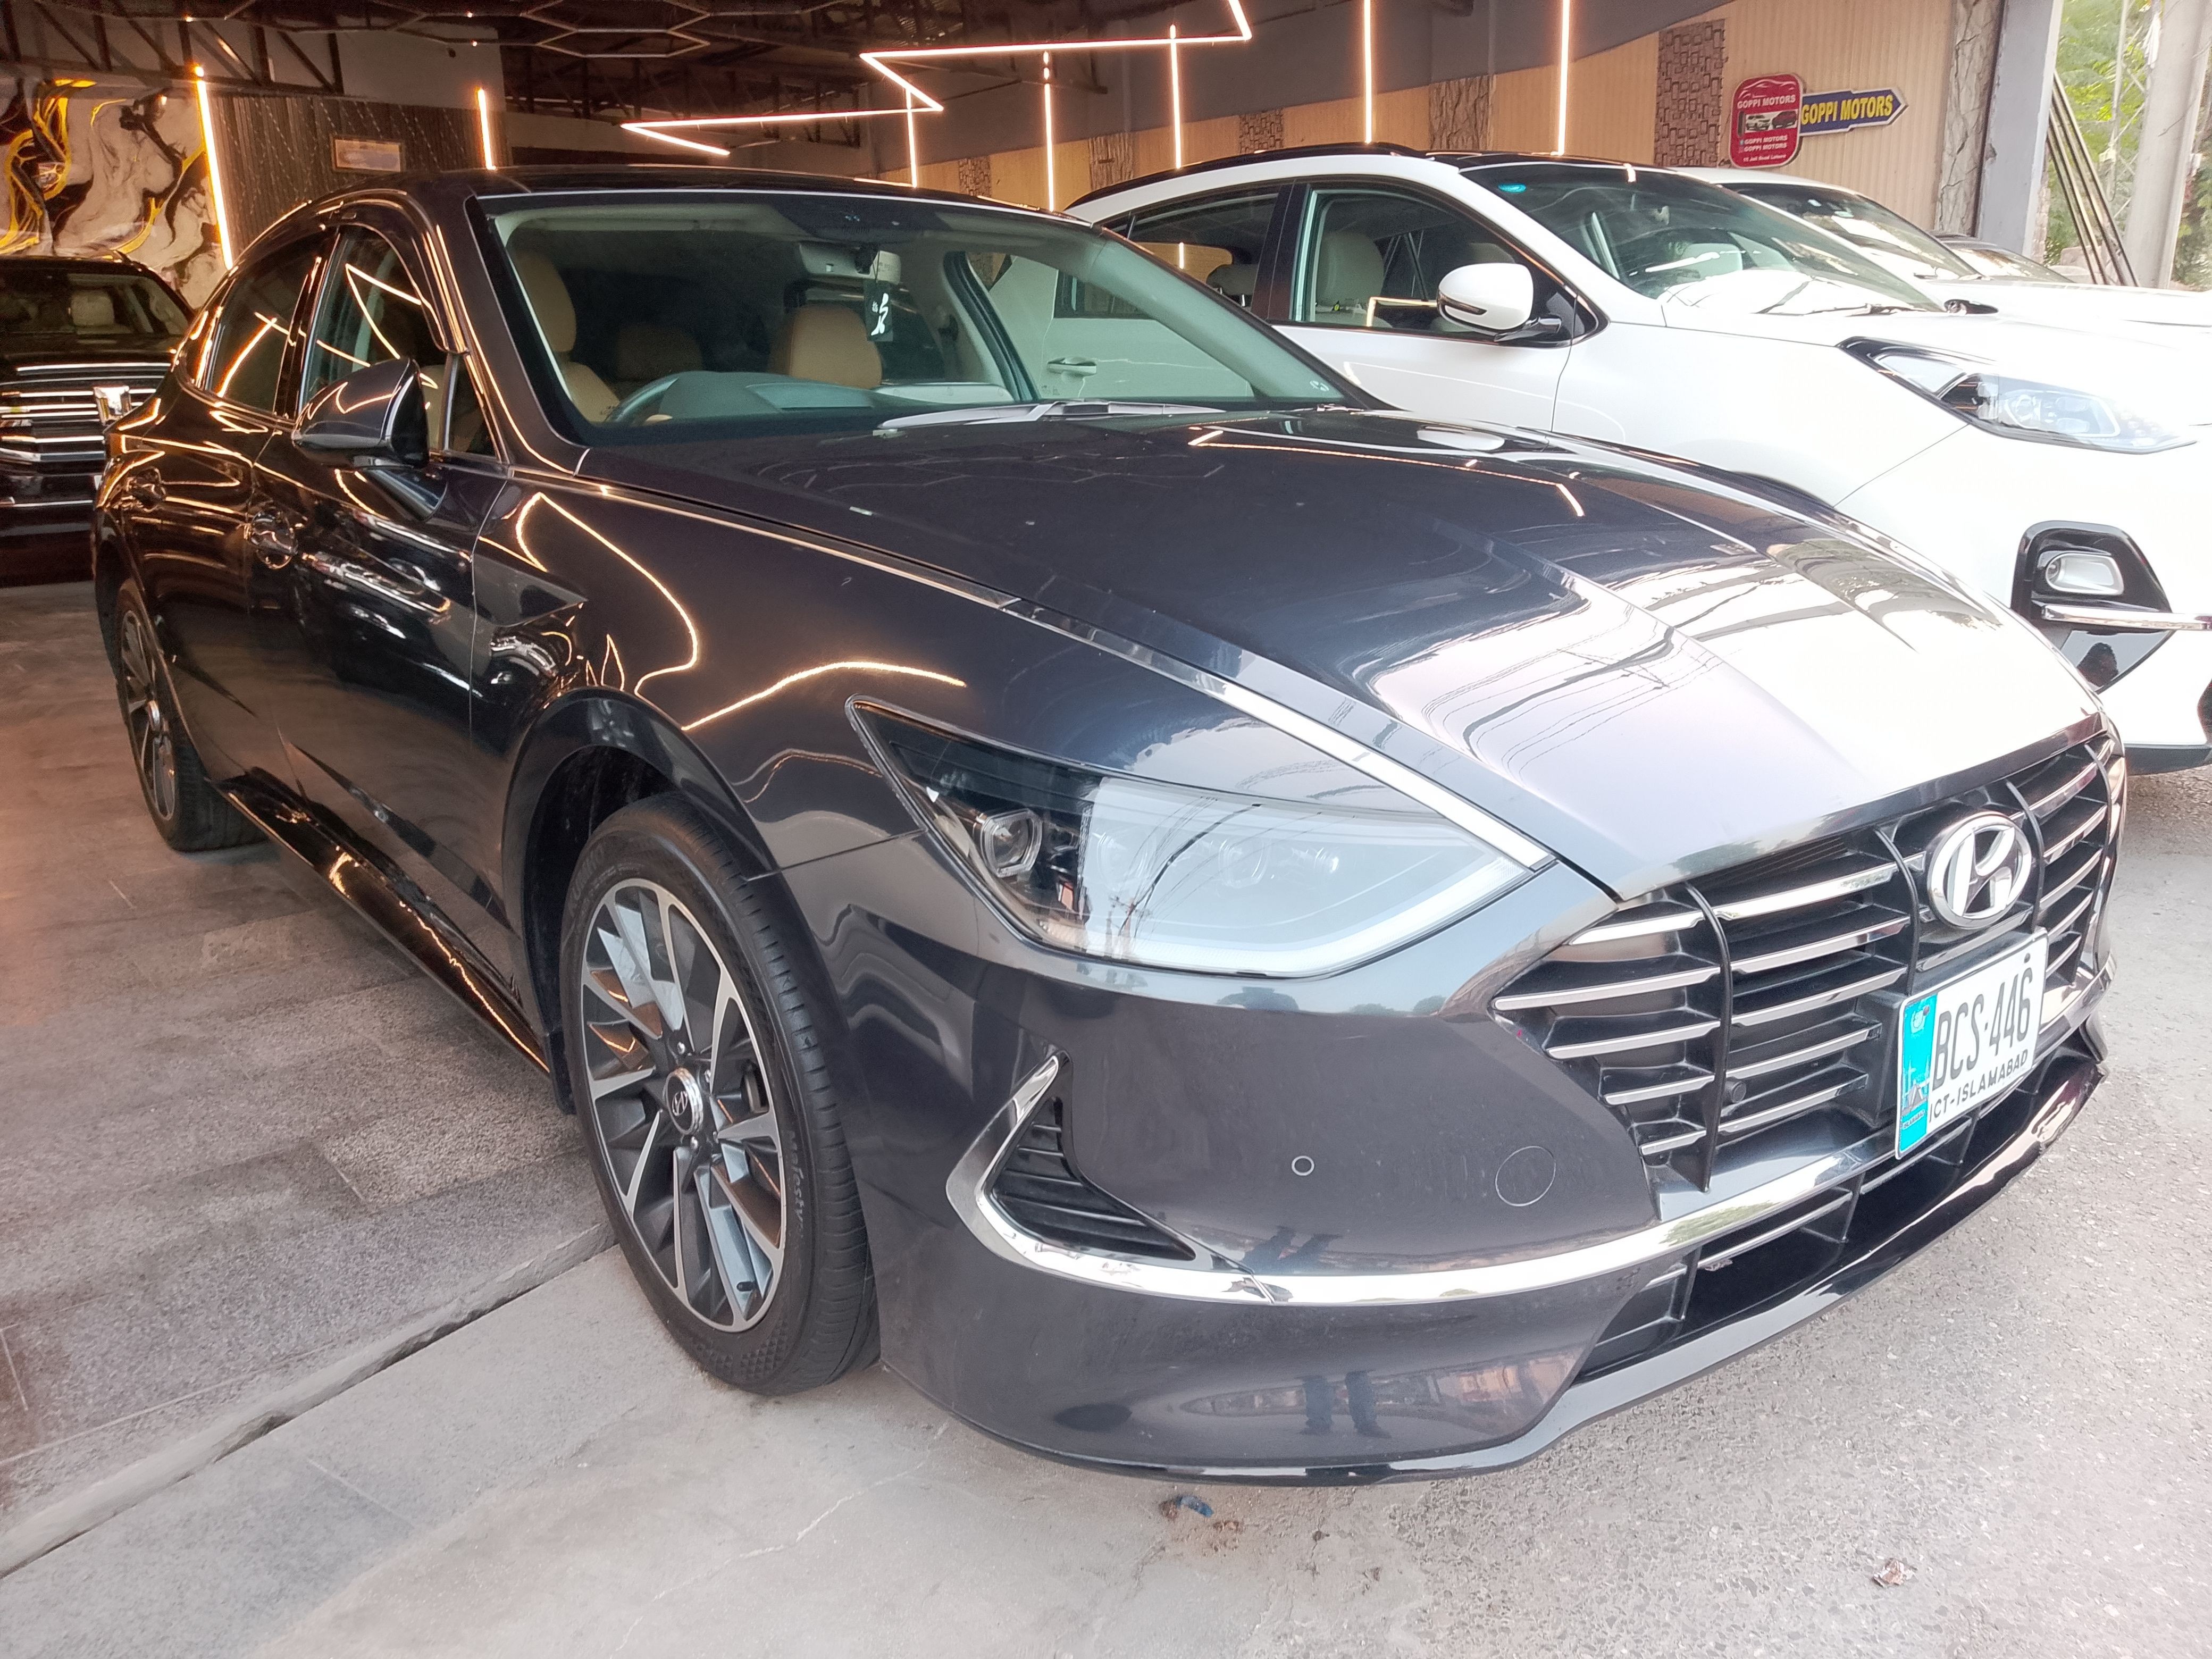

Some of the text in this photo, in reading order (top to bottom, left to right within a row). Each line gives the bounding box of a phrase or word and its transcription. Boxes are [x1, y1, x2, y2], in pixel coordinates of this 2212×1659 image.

[1737, 95, 1796, 109] GOPPI MOTORS
[1800, 95, 1893, 125] GOPPI MOTORS
[1929, 1049, 2029, 1124] ICT-ISLAMABAD
